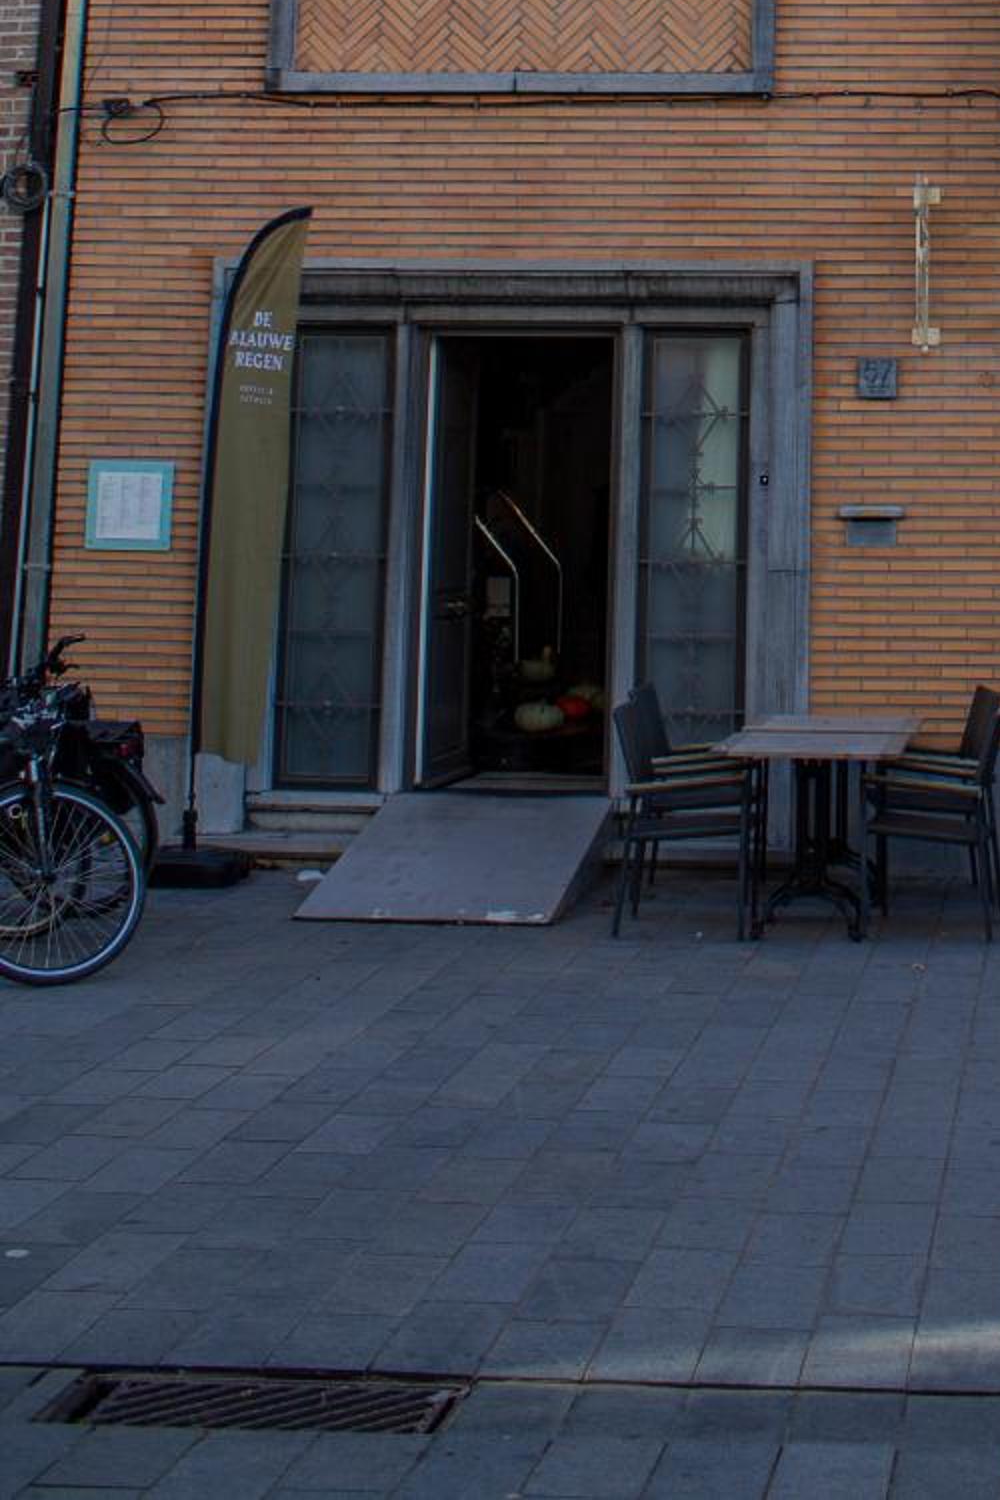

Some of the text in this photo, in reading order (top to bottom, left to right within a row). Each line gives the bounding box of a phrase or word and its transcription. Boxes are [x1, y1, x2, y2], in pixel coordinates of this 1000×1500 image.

[254, 311, 273, 327] DE
[229, 329, 294, 351] BLAUWE
[234, 351, 284, 371] REGEN
[864, 360, 893, 388] 57
